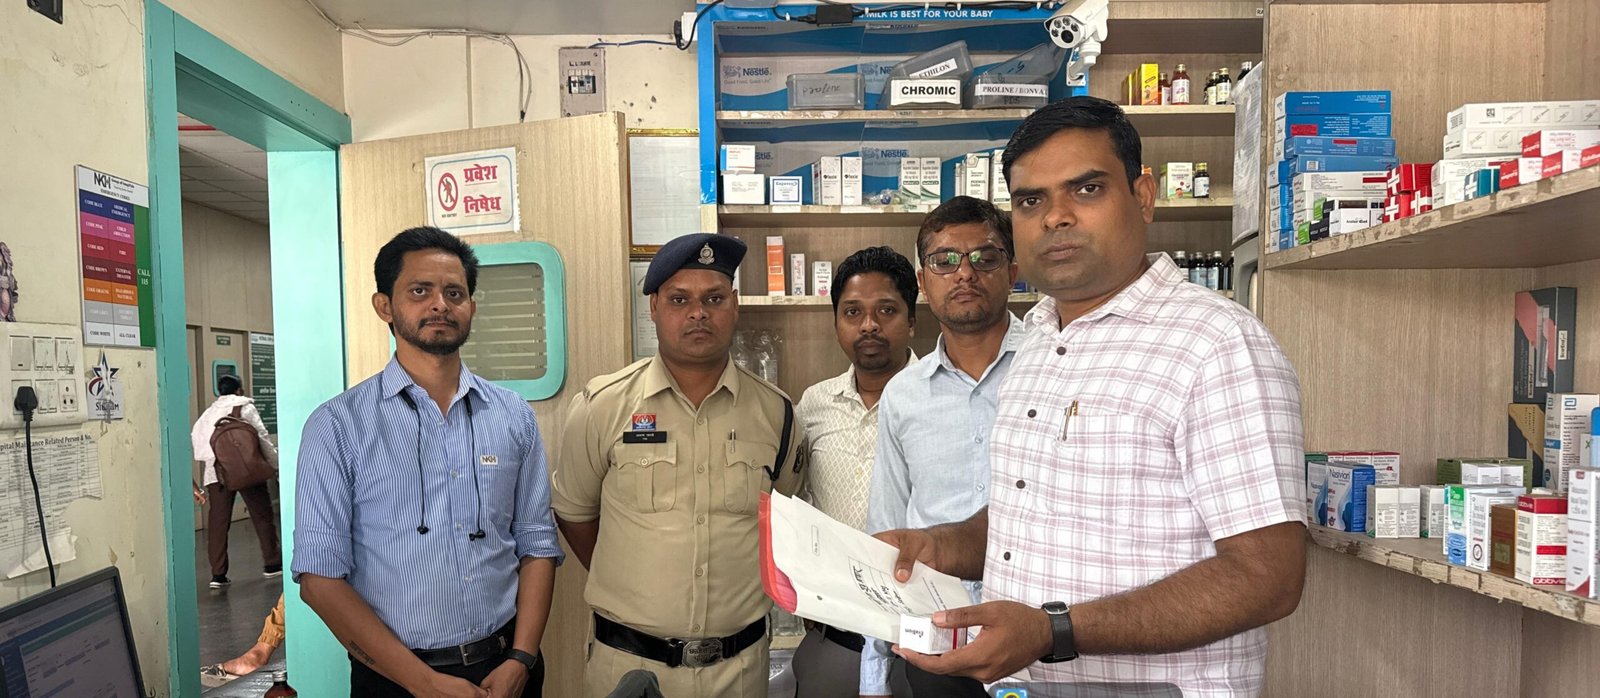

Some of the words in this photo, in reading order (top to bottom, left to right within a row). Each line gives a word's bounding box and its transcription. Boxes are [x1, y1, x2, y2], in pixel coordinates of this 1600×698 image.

[890, 10, 898, 18] IS
[900, 10, 921, 18] BEST
[923, 10, 941, 18] FOR
[943, 10, 969, 18] YOUR
[970, 10, 993, 18] BABY
[901, 86, 956, 96] CHROMIC
[463, 164, 498, 183] प्रवेश
[94, 172, 112, 189] NKH
[463, 195, 501, 214] निषेध
[137, 268, 151, 277] CALL
